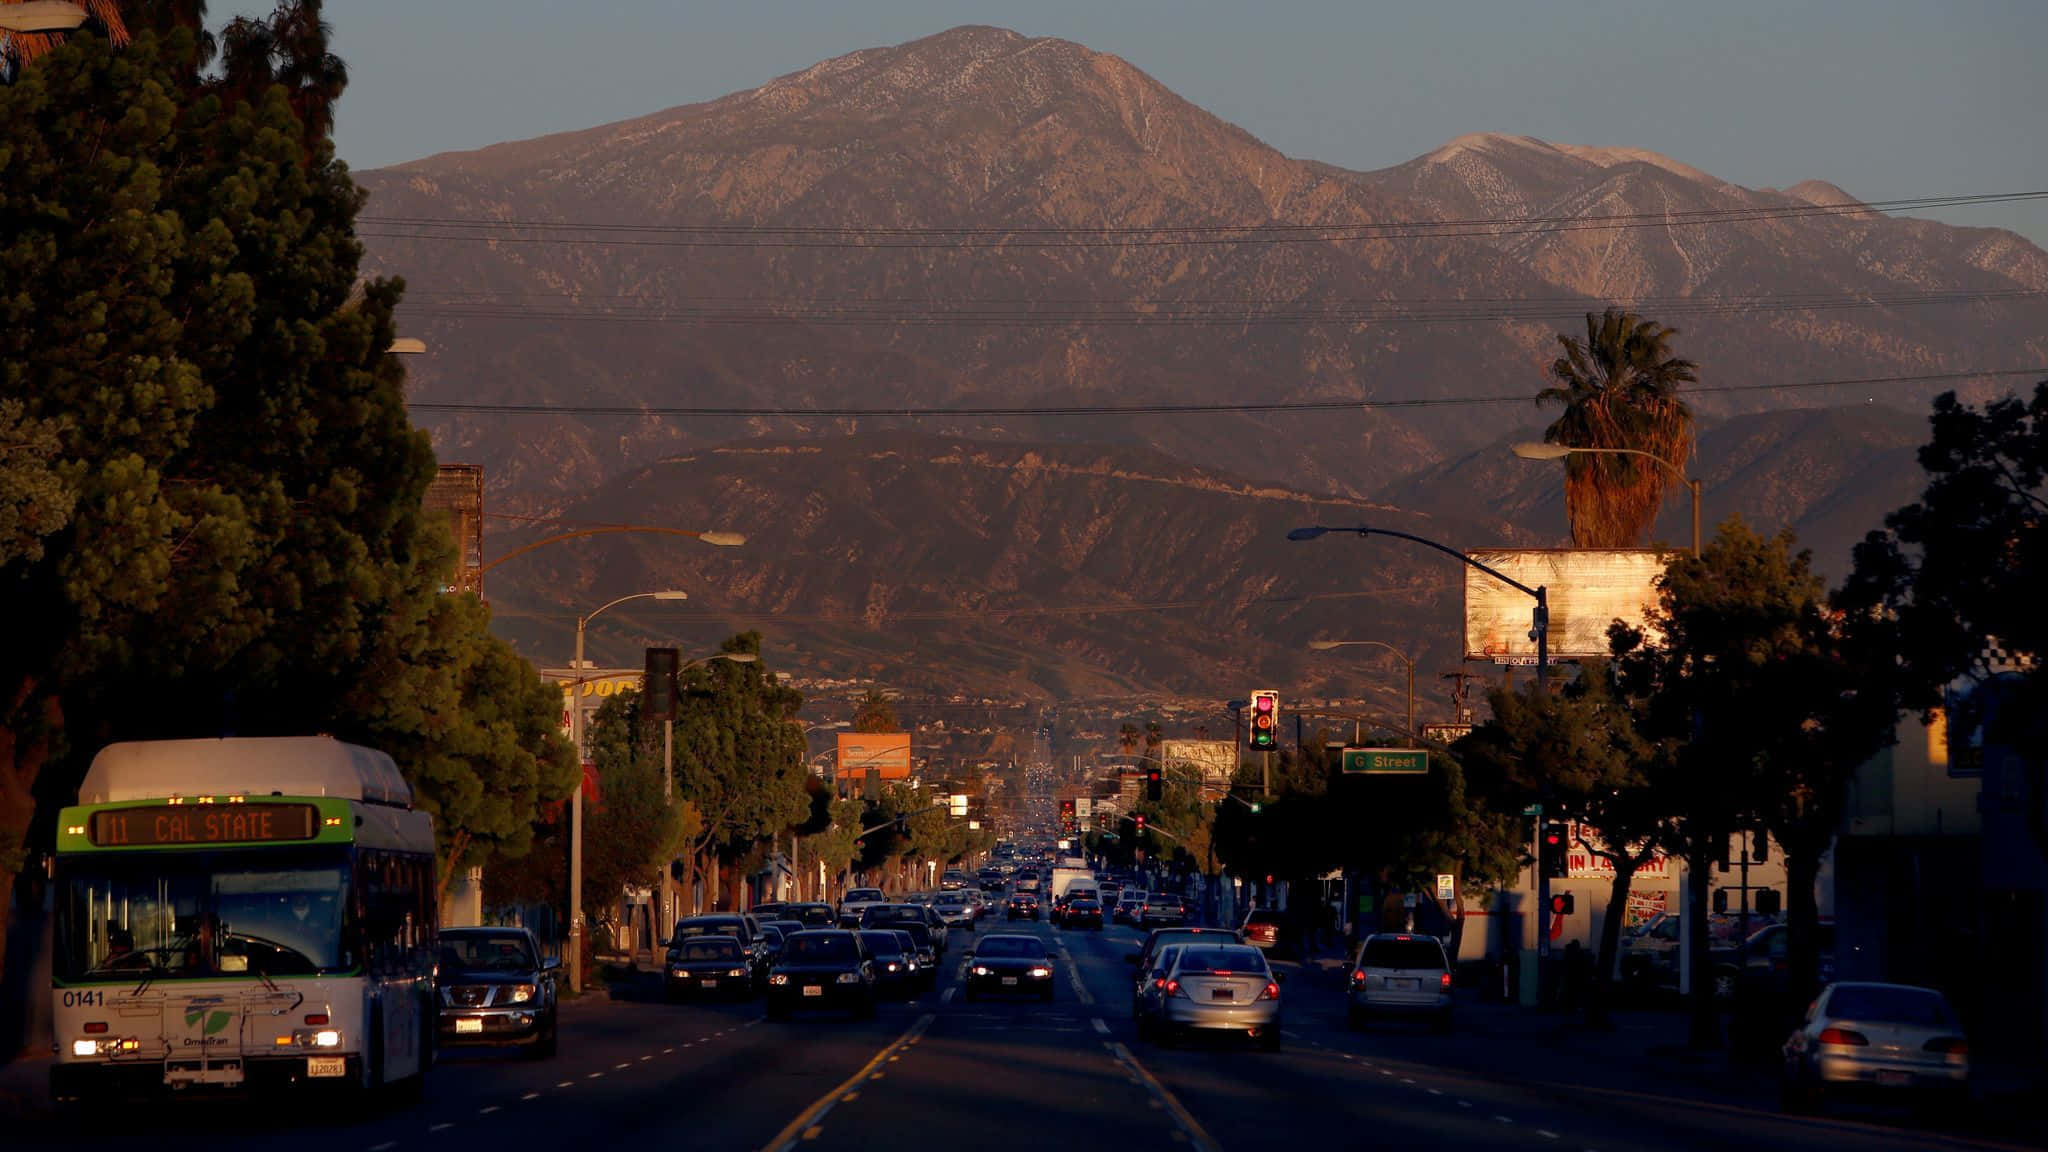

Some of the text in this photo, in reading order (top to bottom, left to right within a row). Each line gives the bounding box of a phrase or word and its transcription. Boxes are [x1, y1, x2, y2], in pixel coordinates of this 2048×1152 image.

[1354, 755, 1417, 768] G Street
[109, 811, 273, 844] 11 CAL STATE
[1591, 855, 1665, 872] LARY
[63, 991, 104, 1008] 0141
